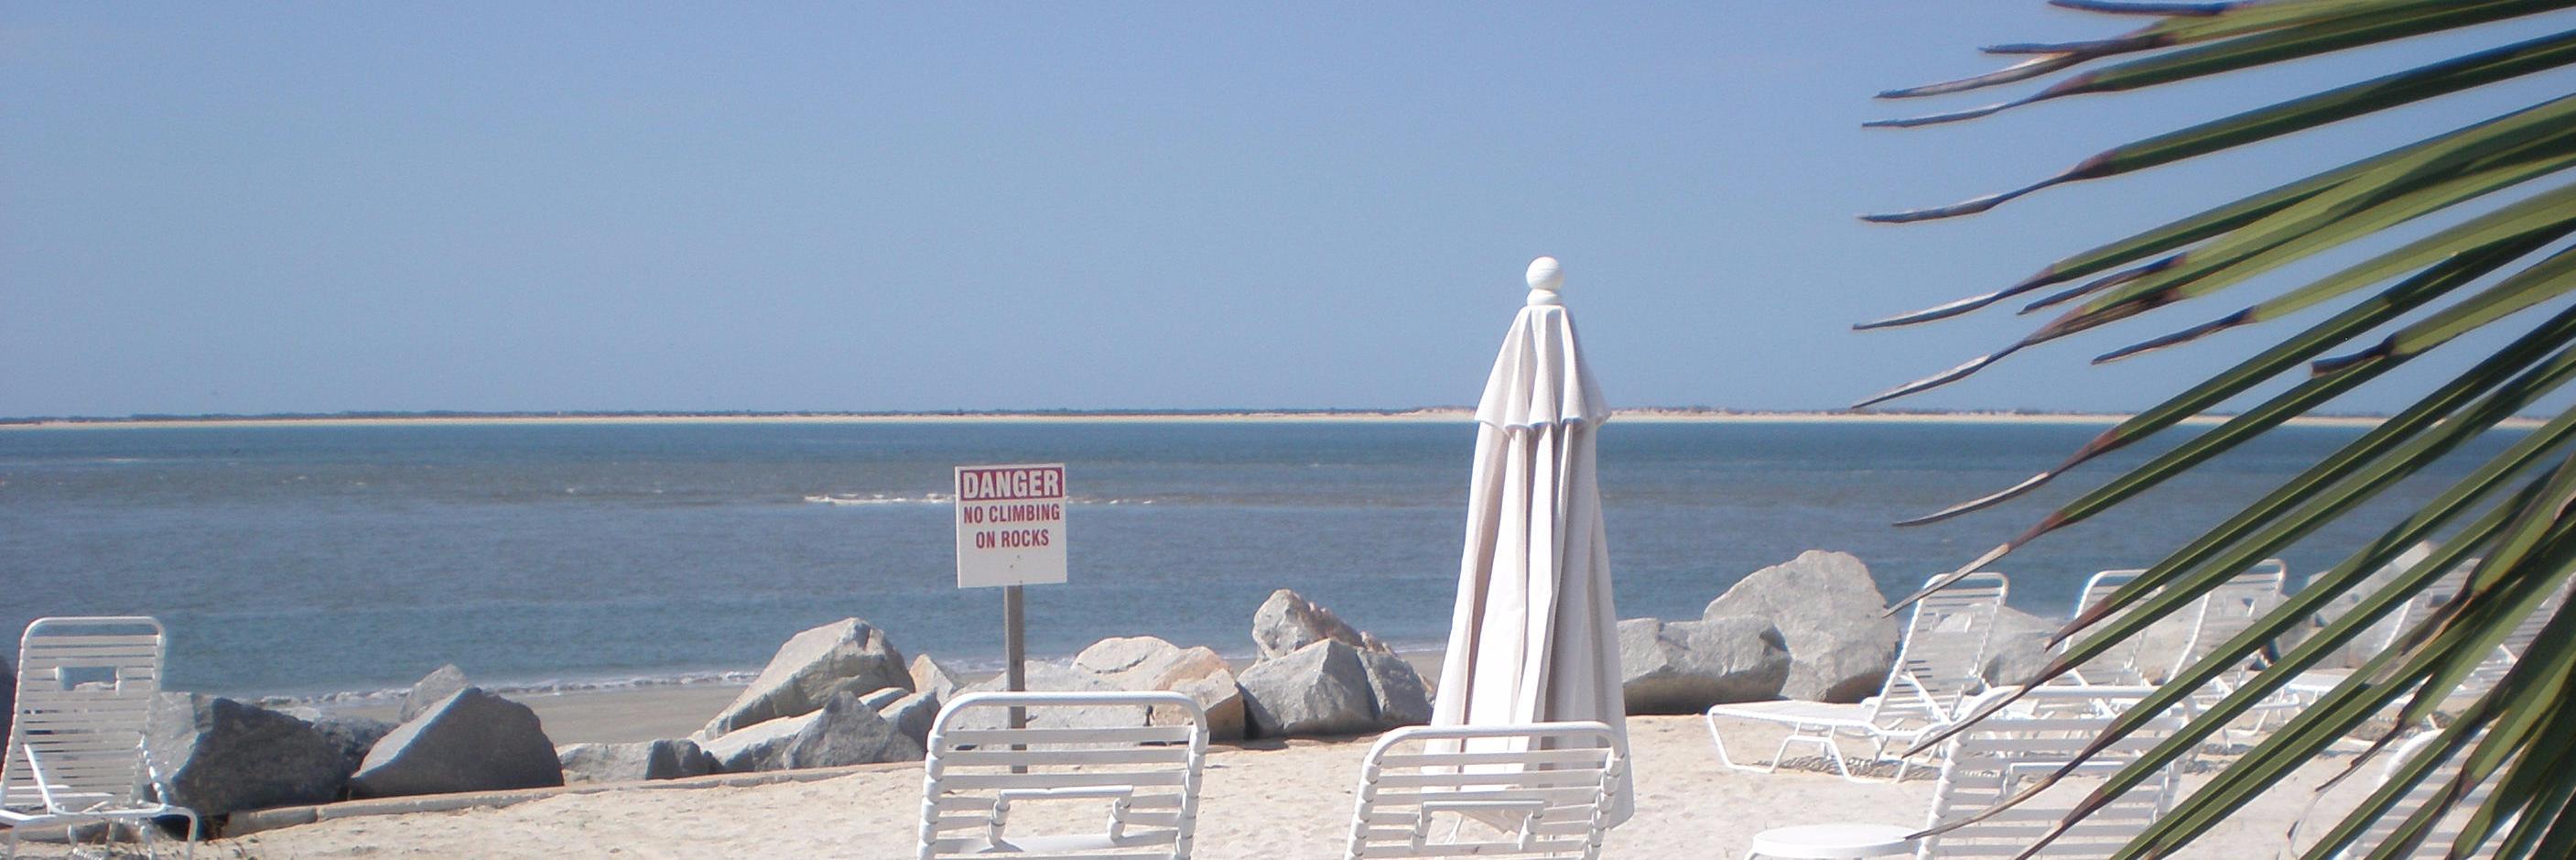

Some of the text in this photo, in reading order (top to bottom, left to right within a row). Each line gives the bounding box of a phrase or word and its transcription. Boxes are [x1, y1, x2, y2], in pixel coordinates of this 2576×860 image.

[963, 470, 1059, 498] DANGER
[964, 504, 1060, 523] NO CLIMBING
[976, 529, 1049, 549] ON ROCKS
